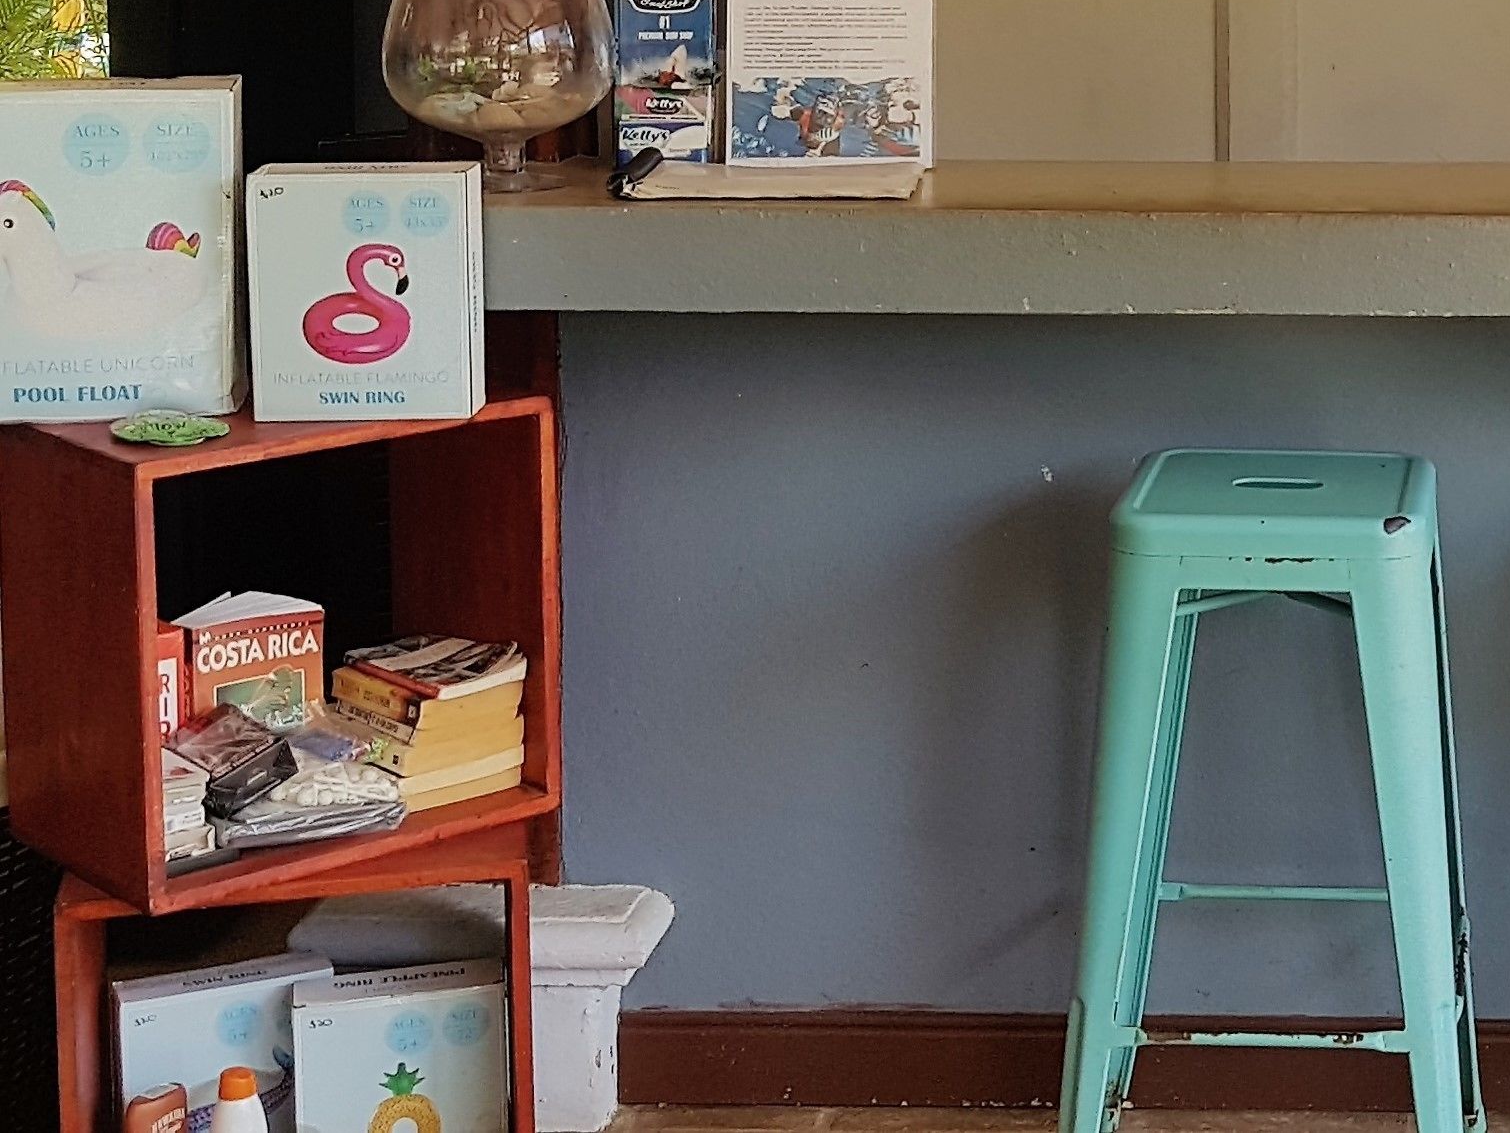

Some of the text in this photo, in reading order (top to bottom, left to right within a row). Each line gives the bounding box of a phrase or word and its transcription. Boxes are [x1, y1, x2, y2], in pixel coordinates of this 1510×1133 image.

[72, 124, 120, 138] AGES
[622, 127, 670, 143] Kelly's
[80, 151, 112, 168] 5+
[100, 355, 194, 373] UNICORN
[272, 371, 449, 385] INFLATABLE FLAMINGO
[13, 384, 142, 403] POOL FLOAT
[319, 391, 406, 404] SWIN RING
[197, 637, 265, 674] COSTA
[267, 628, 320, 661] RICA
